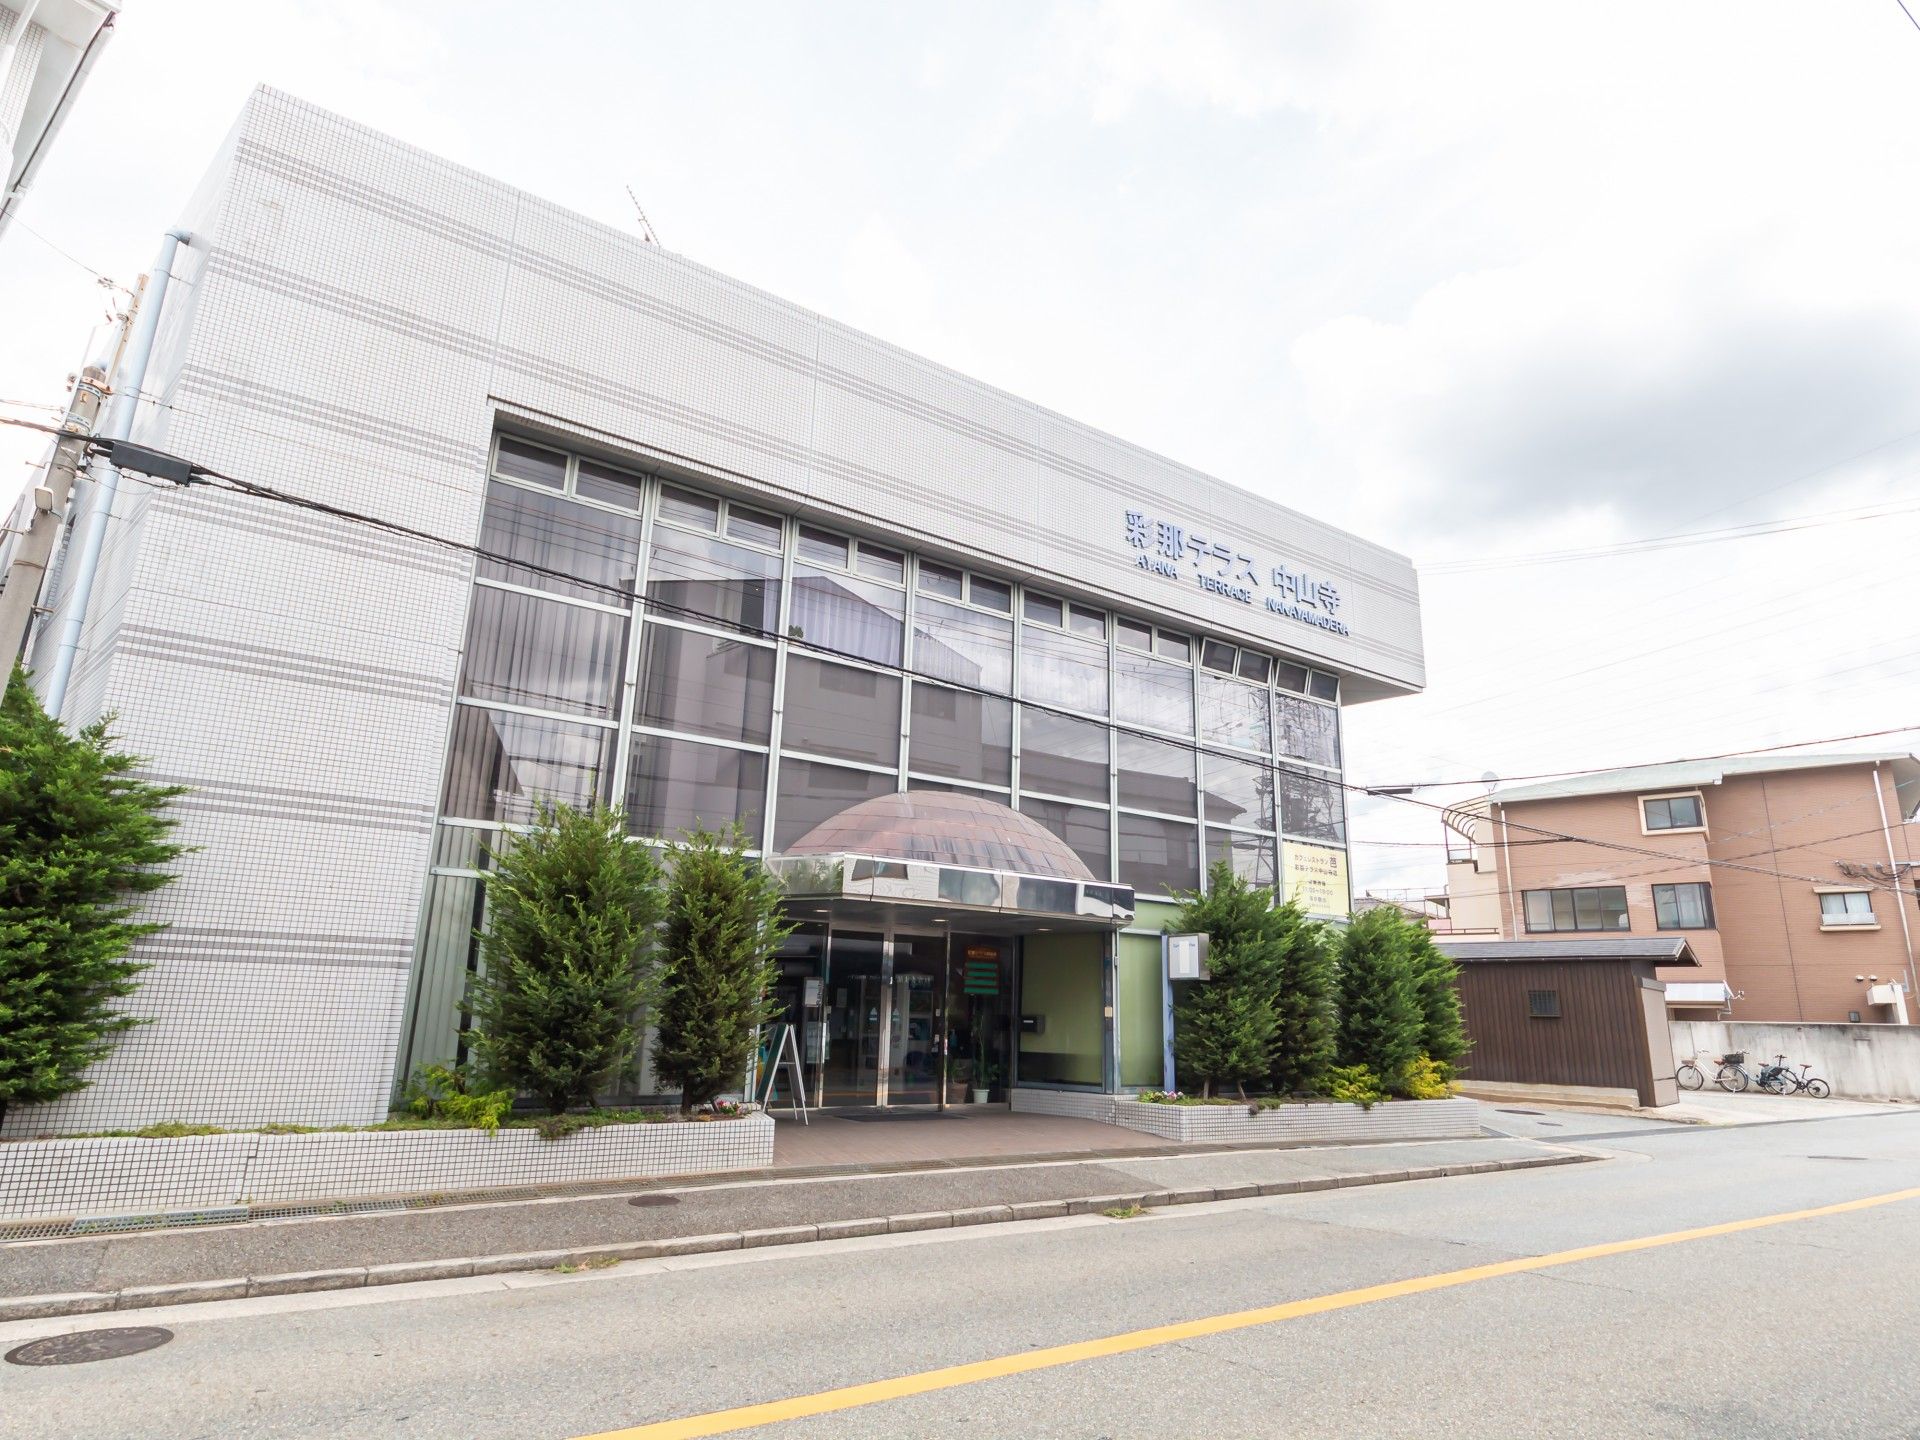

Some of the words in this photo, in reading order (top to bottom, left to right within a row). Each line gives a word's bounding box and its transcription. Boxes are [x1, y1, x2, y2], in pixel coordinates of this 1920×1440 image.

[1125, 509, 1258, 586] 彩那テラス
[1272, 564, 1341, 615] 中山寺
[1135, 554, 1178, 580] AYANA
[1197, 573, 1252, 604] TERRACE
[1265, 596, 1351, 636] NAKAYAMADERA
